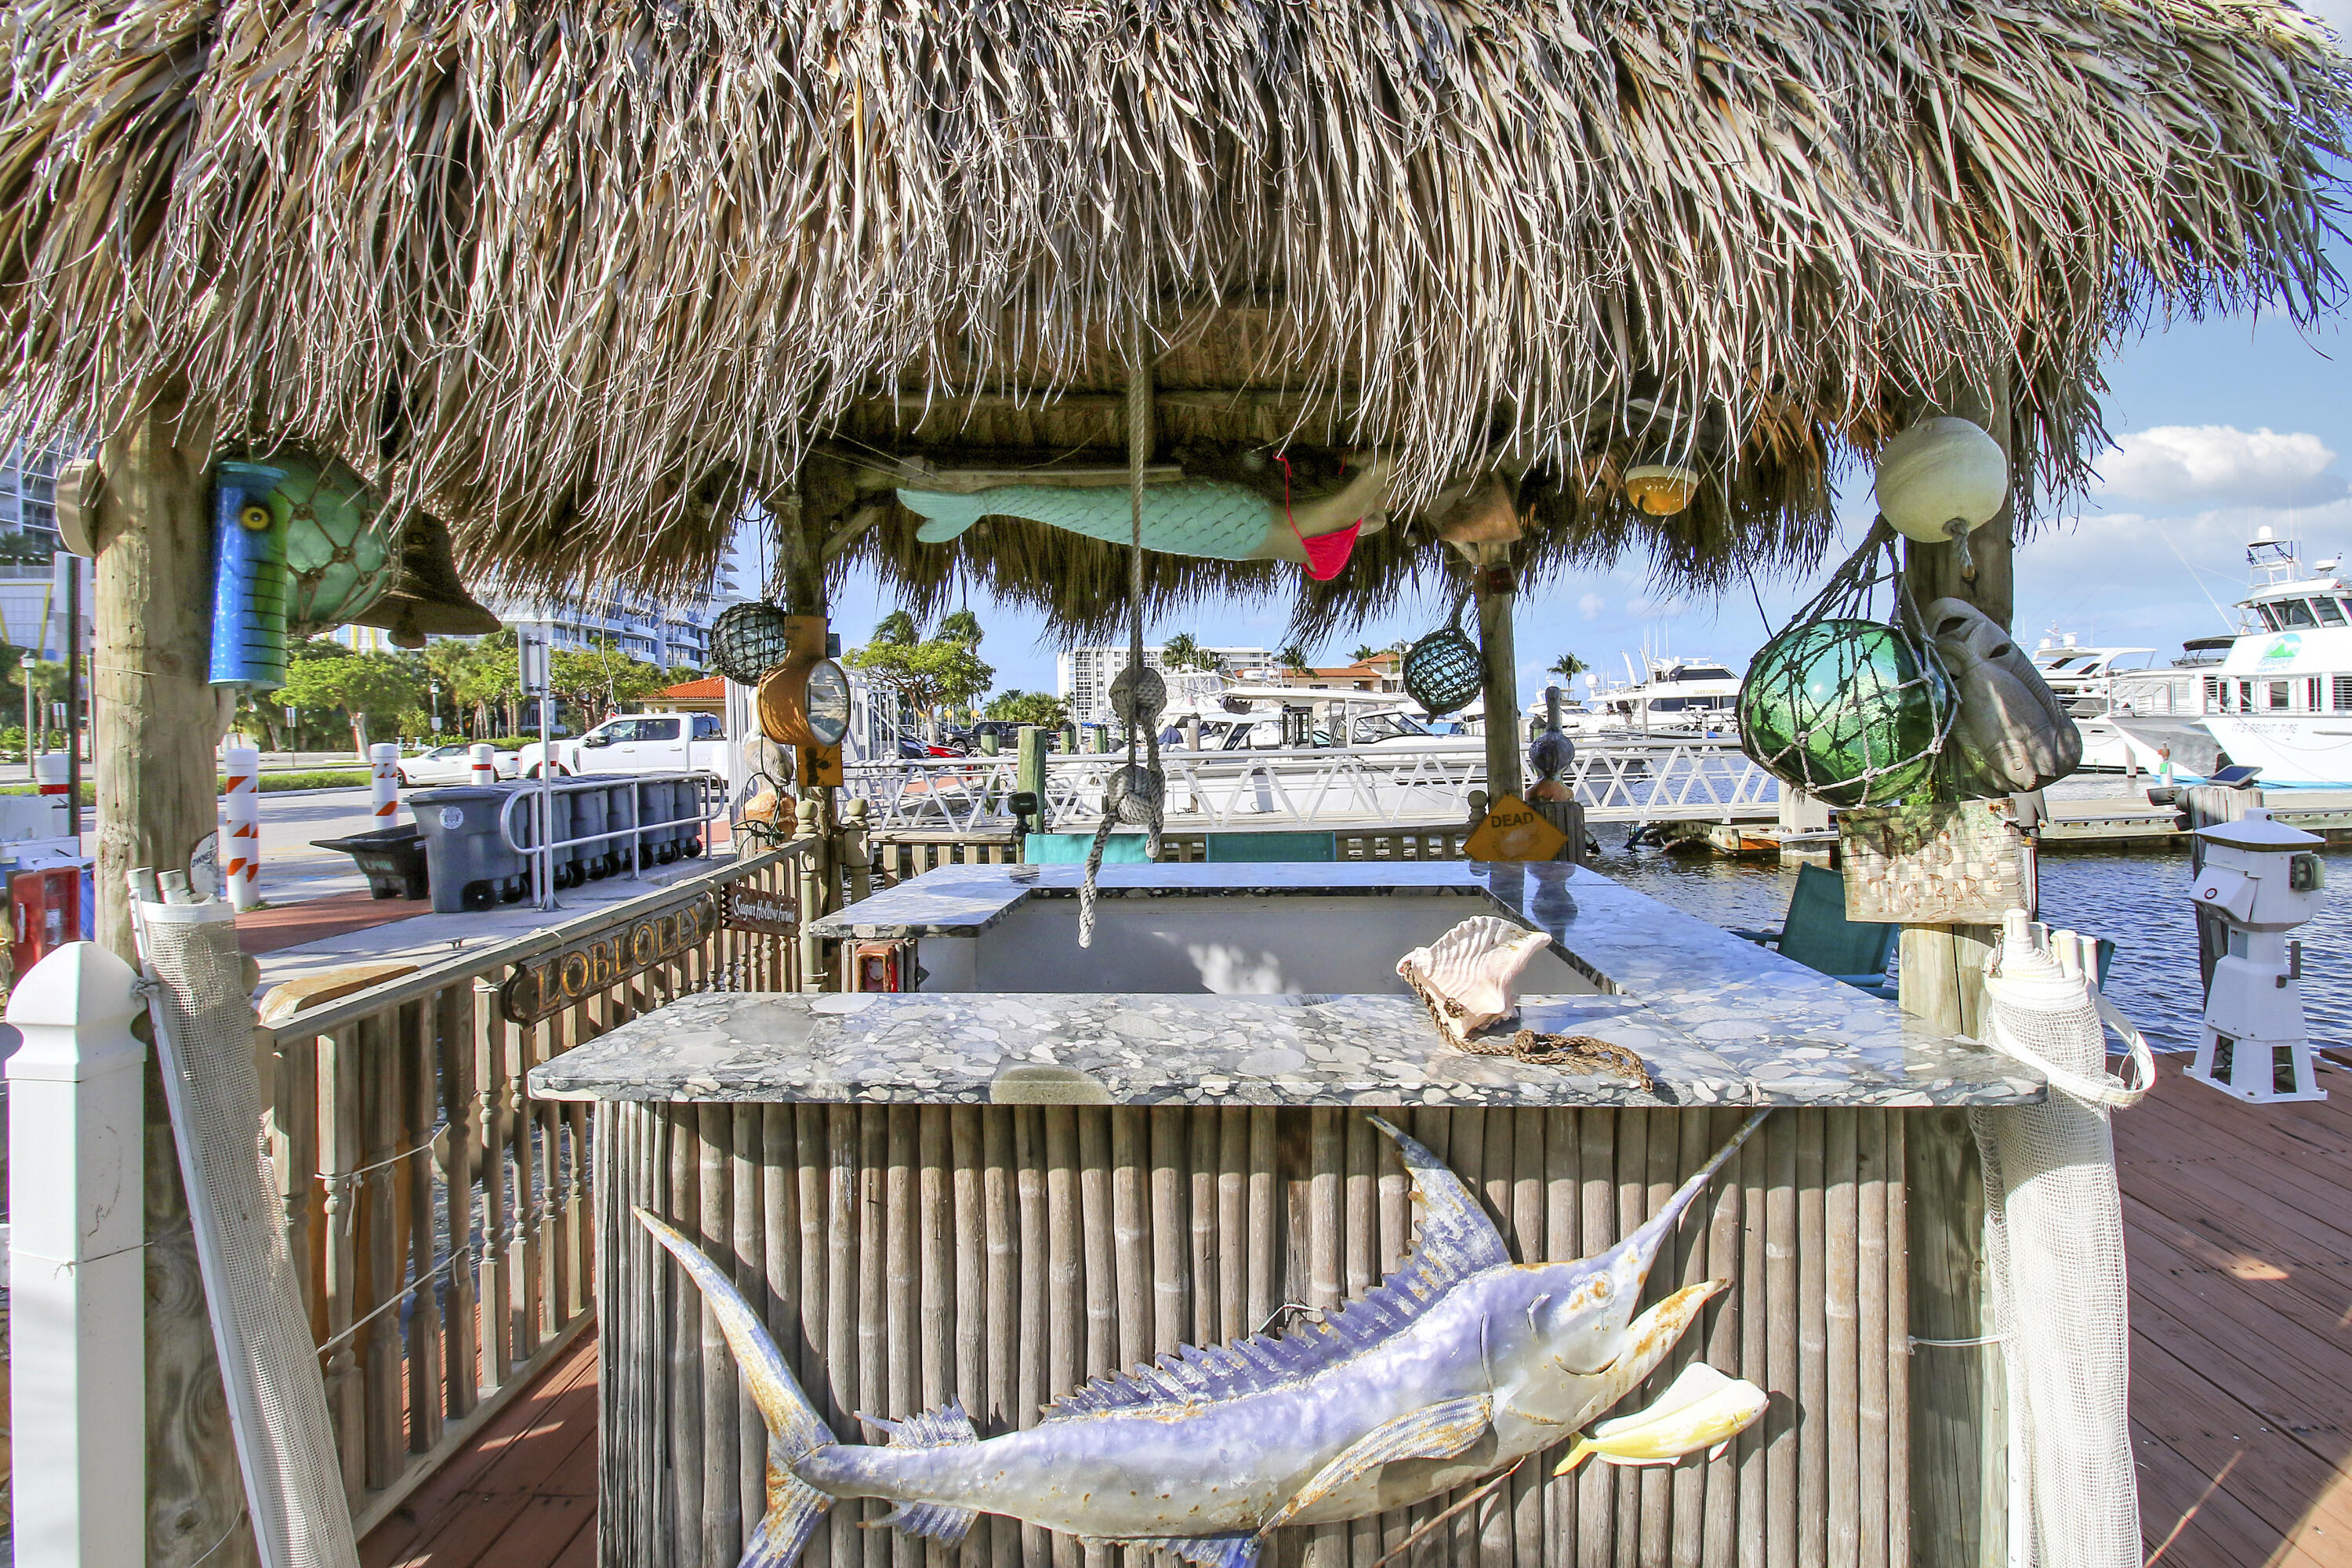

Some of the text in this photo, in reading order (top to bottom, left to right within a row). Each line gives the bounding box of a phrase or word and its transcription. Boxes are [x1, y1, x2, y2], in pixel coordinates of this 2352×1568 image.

[1491, 811, 1534, 829] DEAD
[734, 894, 756, 922] Sugar
[756, 898, 778, 922] Hollow
[1927, 873, 1990, 920] BAR
[532, 902, 704, 1014] LOBLOLLY
